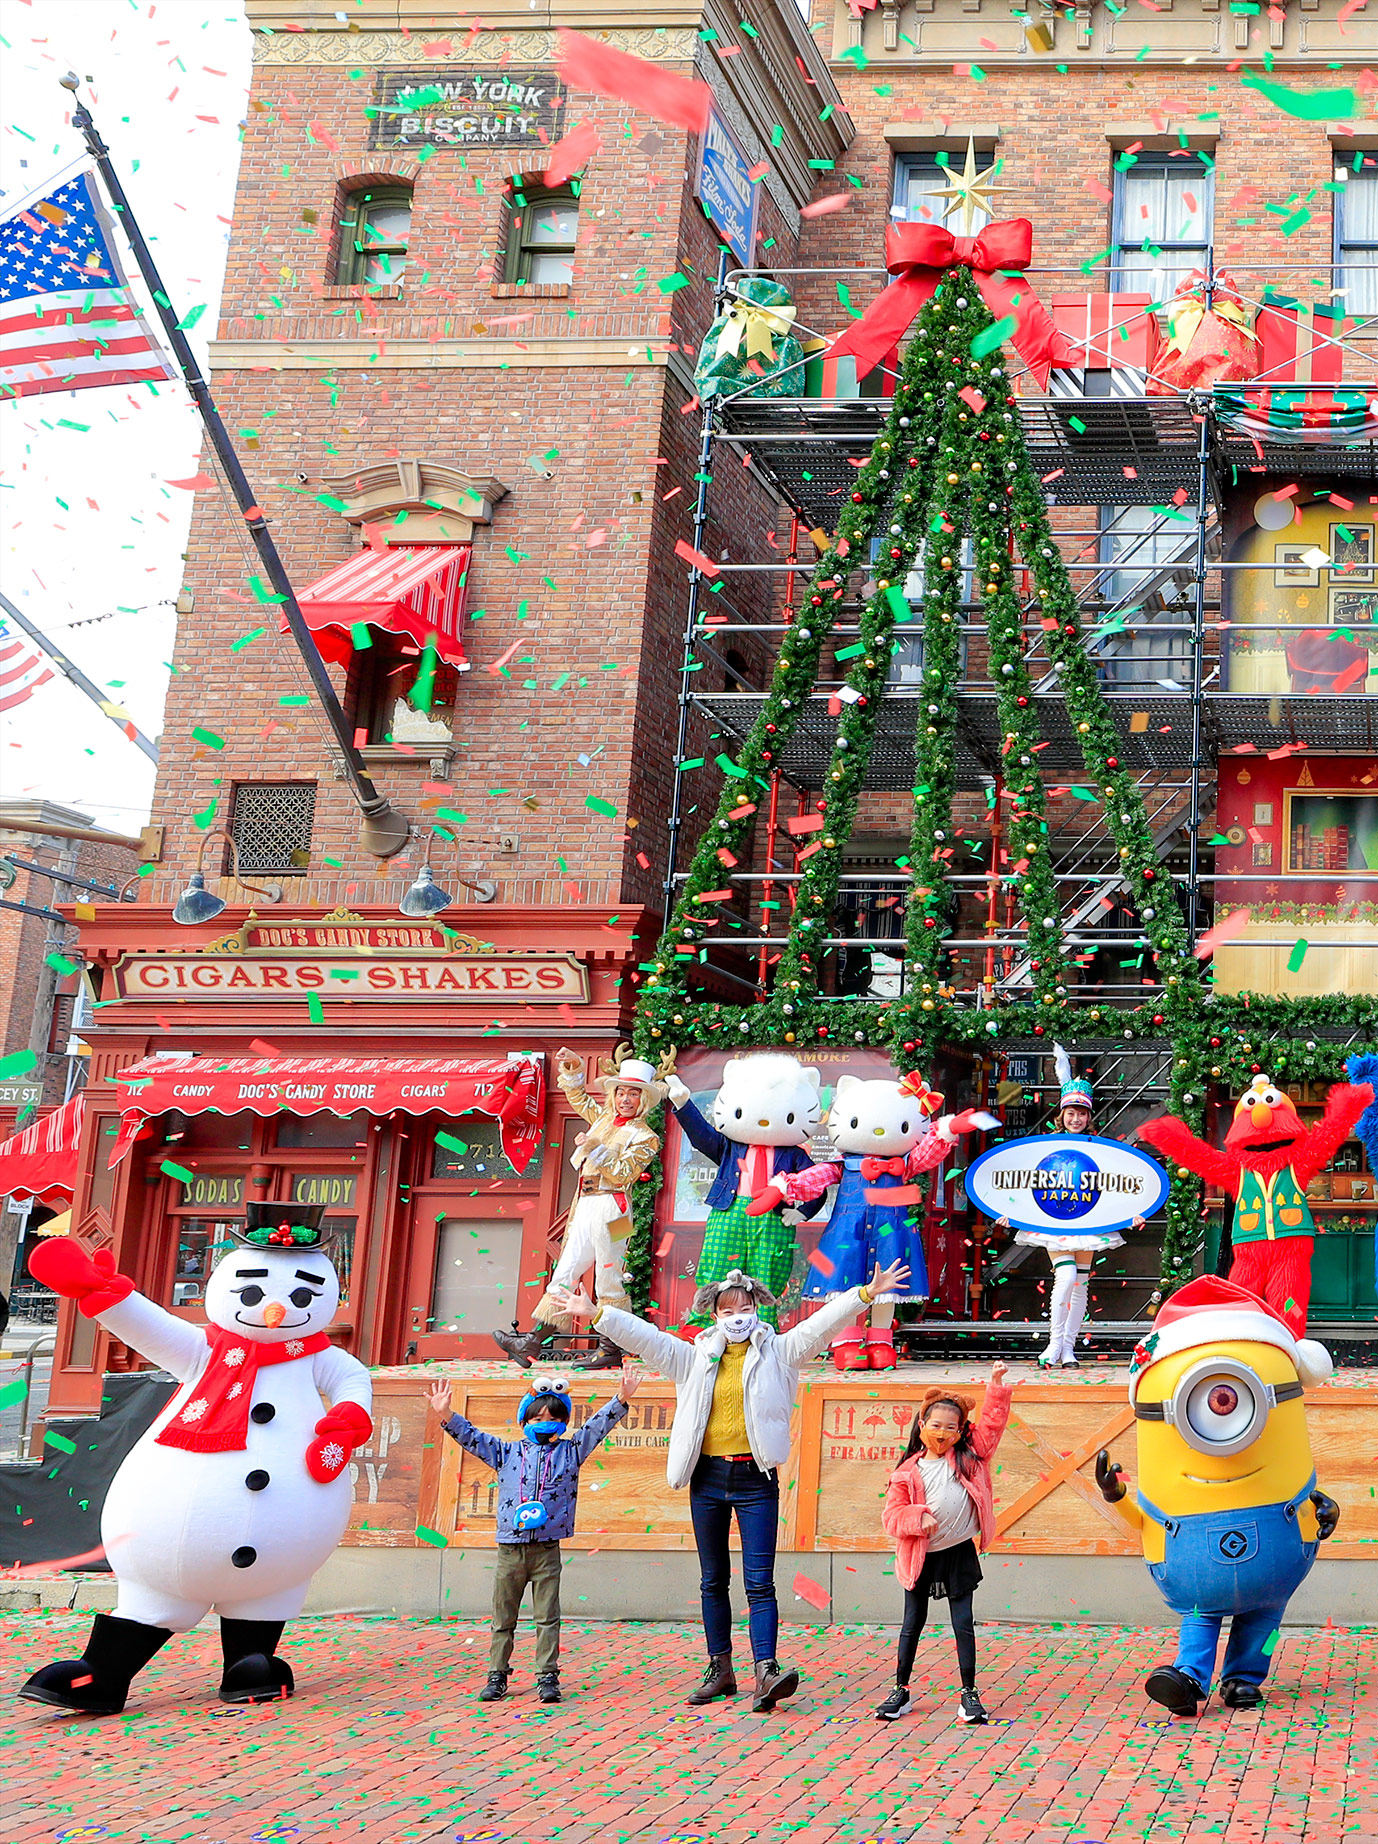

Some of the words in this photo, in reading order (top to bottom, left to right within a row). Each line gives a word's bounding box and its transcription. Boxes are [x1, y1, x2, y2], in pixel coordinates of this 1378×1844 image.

[472, 82, 545, 107] YORK
[401, 117, 534, 134] BISCUIT
[315, 928, 370, 947] CANDY
[377, 928, 434, 947] STORE
[139, 965, 325, 988] CIGARS
[367, 966, 566, 990] SHAKES
[21, 1088, 39, 1101] ST.
[173, 1084, 215, 1097] CANDY
[285, 1084, 327, 1099] CANDY
[333, 1084, 376, 1099] STORE
[401, 1085, 446, 1097] CIGARS
[992, 1169, 1075, 1190] UNIVERSAL
[1080, 1171, 1144, 1195] STUDIOS
[184, 1178, 242, 1204] SODAS
[296, 1178, 353, 1204] CANDY
[1041, 1191, 1092, 1202] JAPAN
[615, 1435, 642, 1447] WITH
[831, 1446, 905, 1460] FRAGIL
